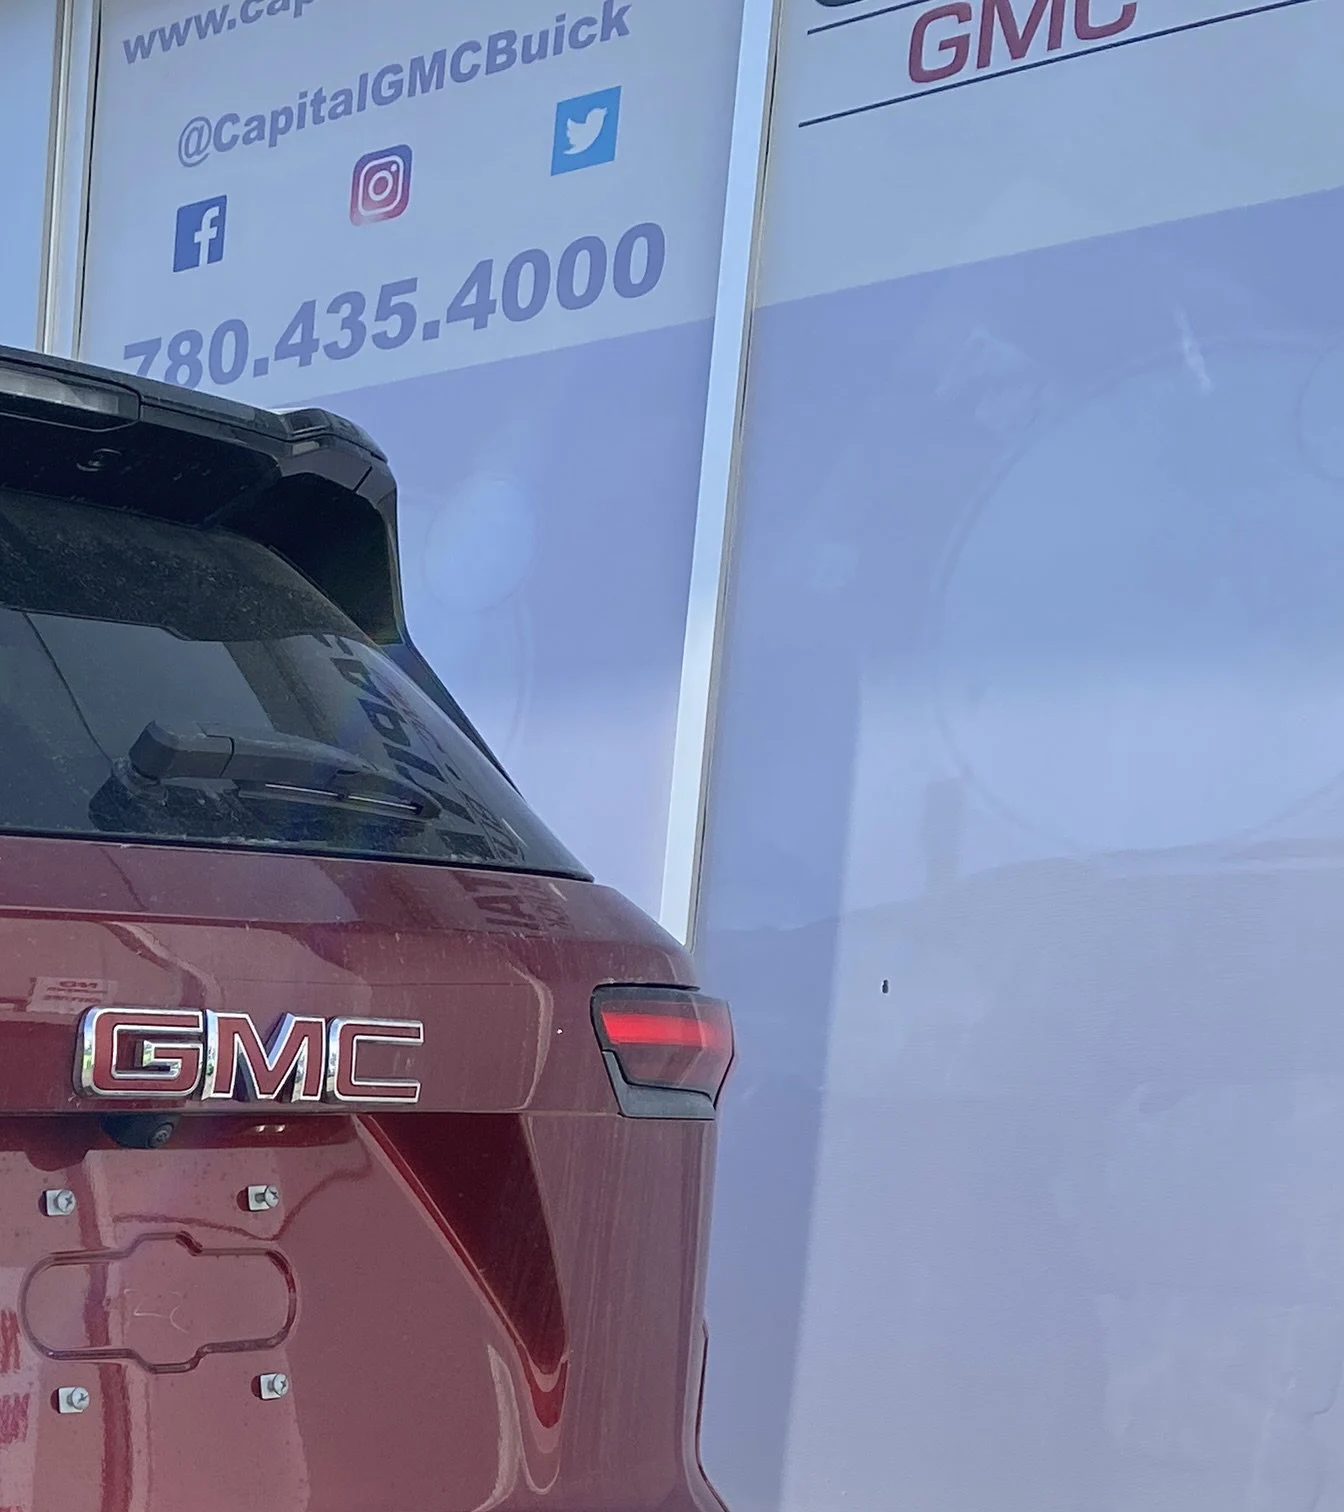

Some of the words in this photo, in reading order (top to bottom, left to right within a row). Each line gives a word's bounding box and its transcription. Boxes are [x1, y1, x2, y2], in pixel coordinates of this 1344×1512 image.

[178, 0, 633, 168] @CapitalGMCBuick
[908, 0, 1138, 84] GMC
[123, 222, 666, 390] 780.435.4000
[72, 1005, 424, 1104] GMC
